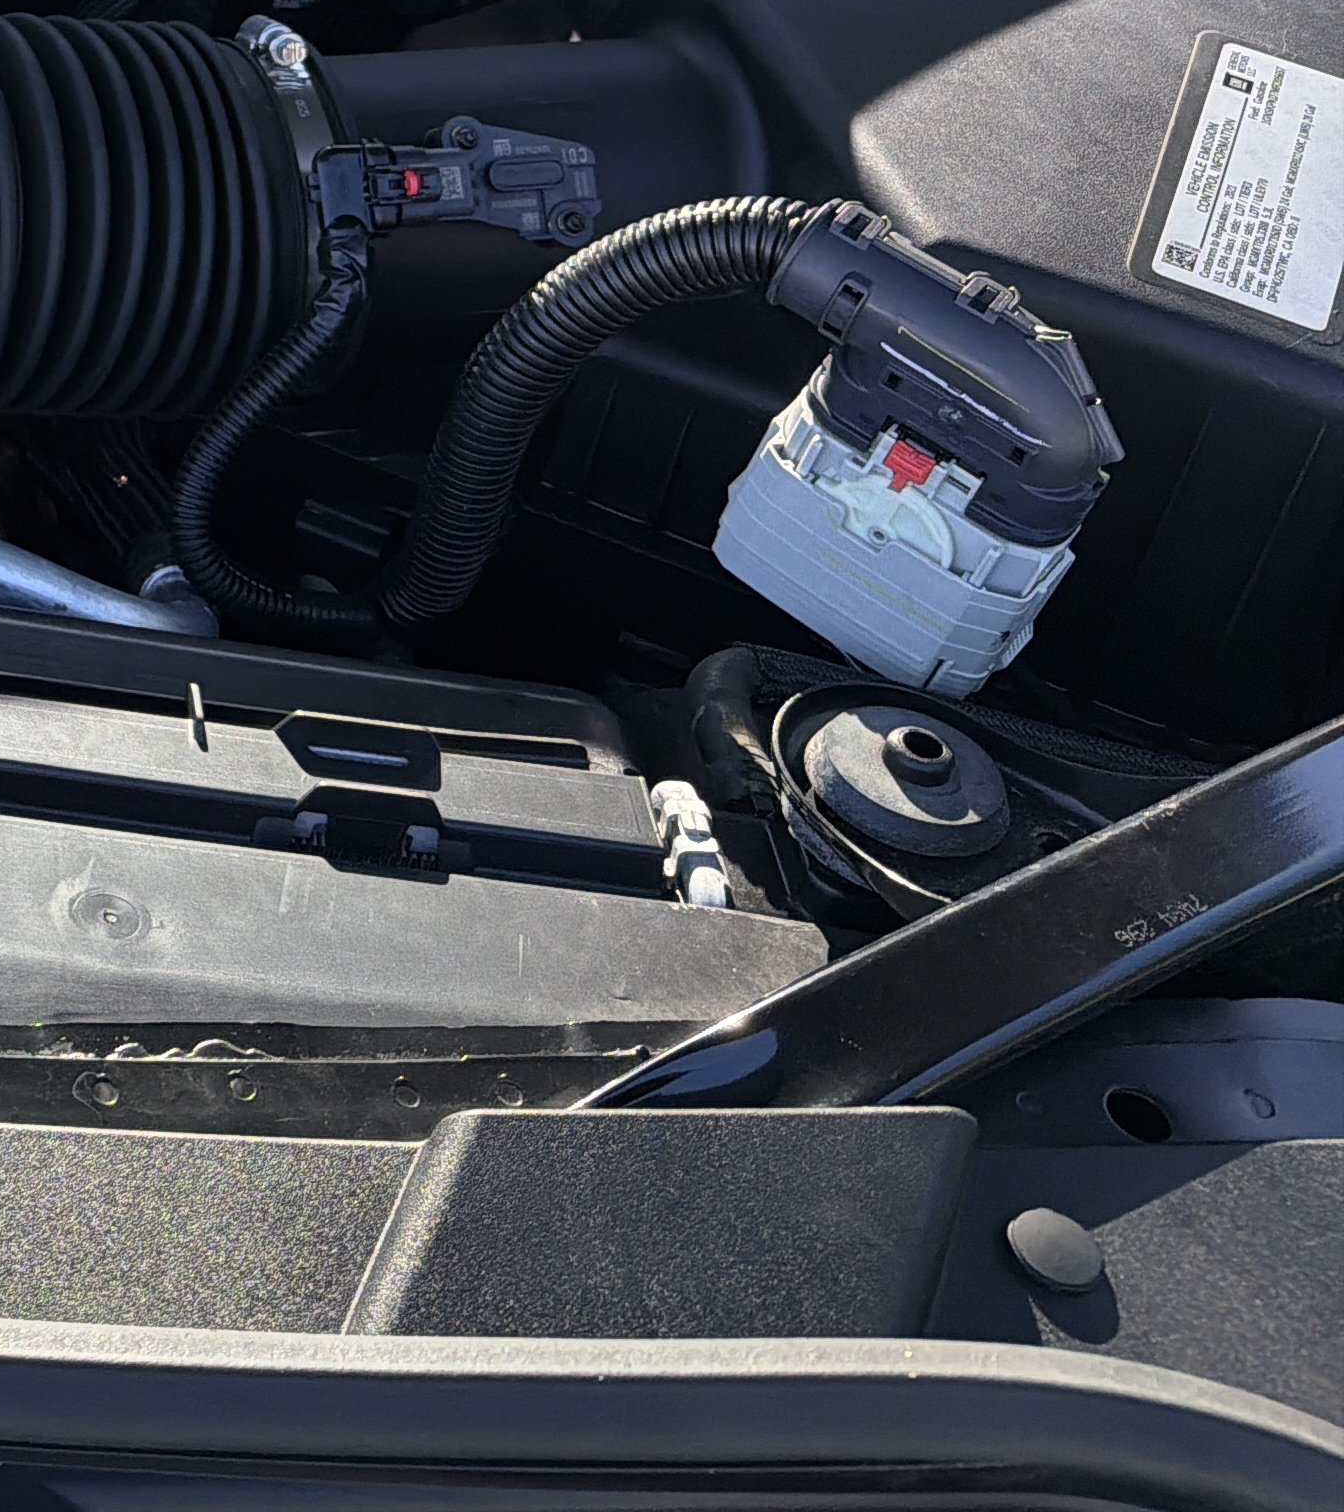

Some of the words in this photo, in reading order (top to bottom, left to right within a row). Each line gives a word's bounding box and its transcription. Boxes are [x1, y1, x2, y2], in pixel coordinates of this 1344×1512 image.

[1185, 160, 1206, 196] VEHICLE
[1197, 121, 1219, 161] EMISSION
[1196, 171, 1219, 214] CONTROL
[1209, 117, 1236, 172] INFORMATION
[1216, 254, 1230, 269] EPA
[1281, 238, 1293, 251] CA
